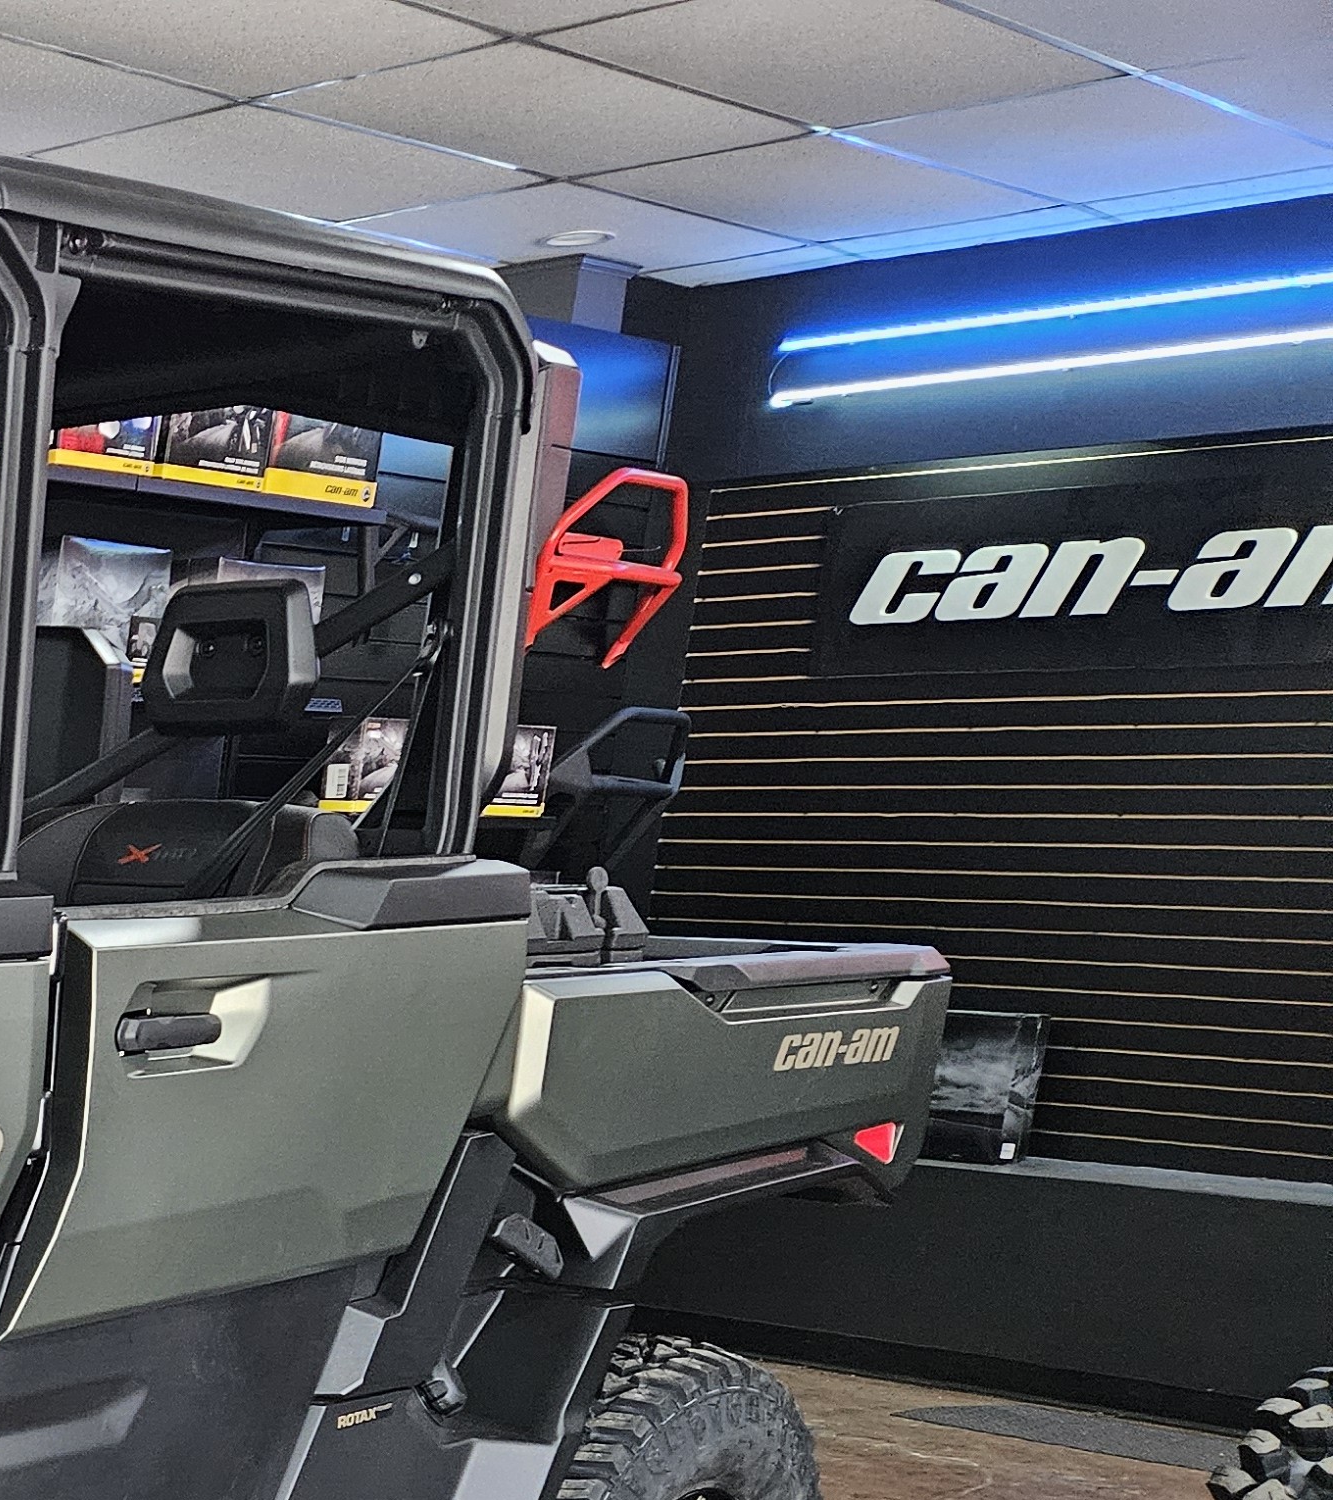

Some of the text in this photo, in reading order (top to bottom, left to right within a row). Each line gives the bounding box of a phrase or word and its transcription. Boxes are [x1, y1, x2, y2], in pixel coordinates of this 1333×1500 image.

[325, 485, 359, 497] can-am
[773, 1026, 901, 1072] can-am
[337, 1407, 377, 1429] ROTAX
